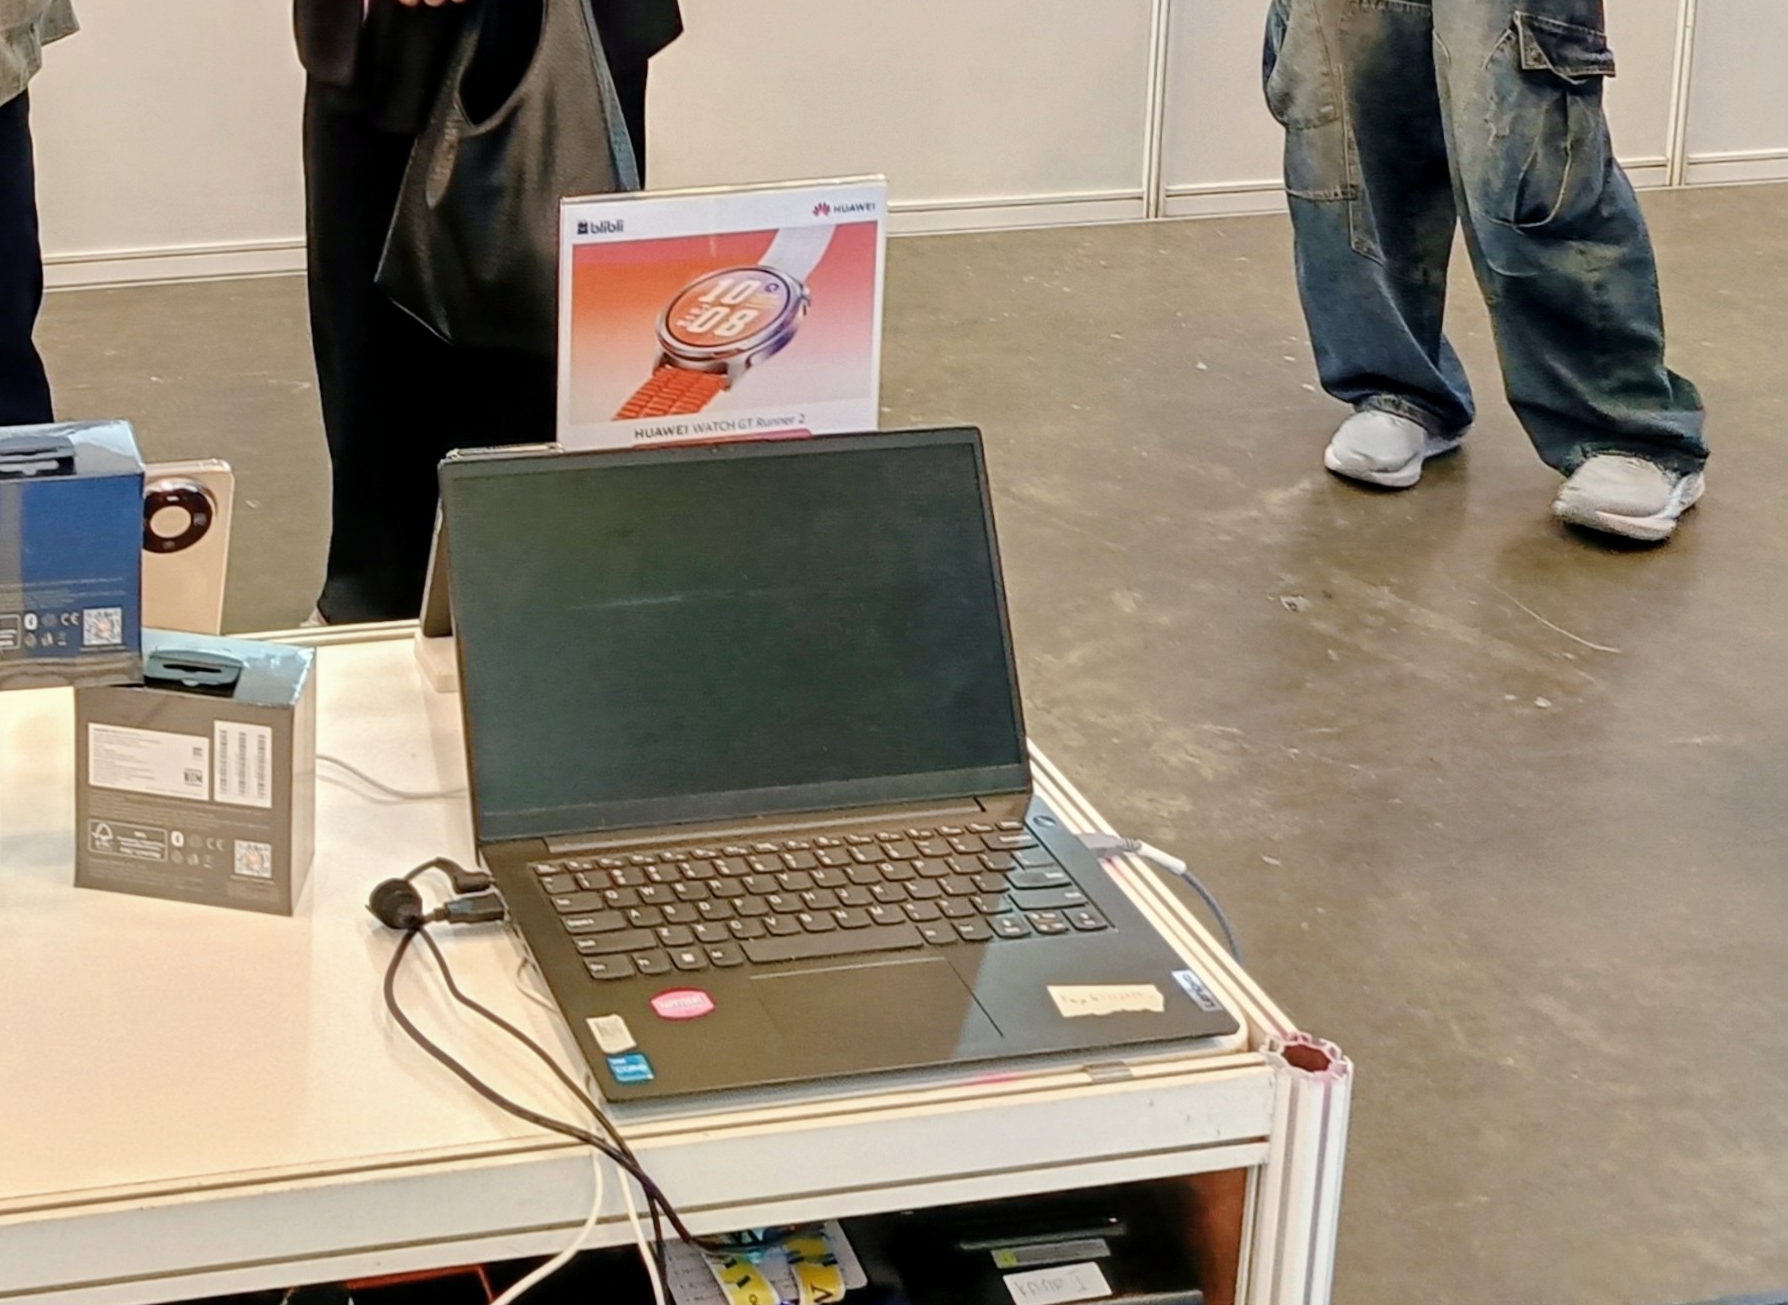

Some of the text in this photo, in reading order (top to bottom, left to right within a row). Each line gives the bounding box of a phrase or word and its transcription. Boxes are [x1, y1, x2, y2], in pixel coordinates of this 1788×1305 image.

[834, 203, 876, 213] HUAWEI
[590, 219, 624, 234] blibli
[698, 279, 762, 305] 10
[686, 306, 759, 337] 08
[634, 413, 805, 439] HUAWEI WATCH GT Runner 2
